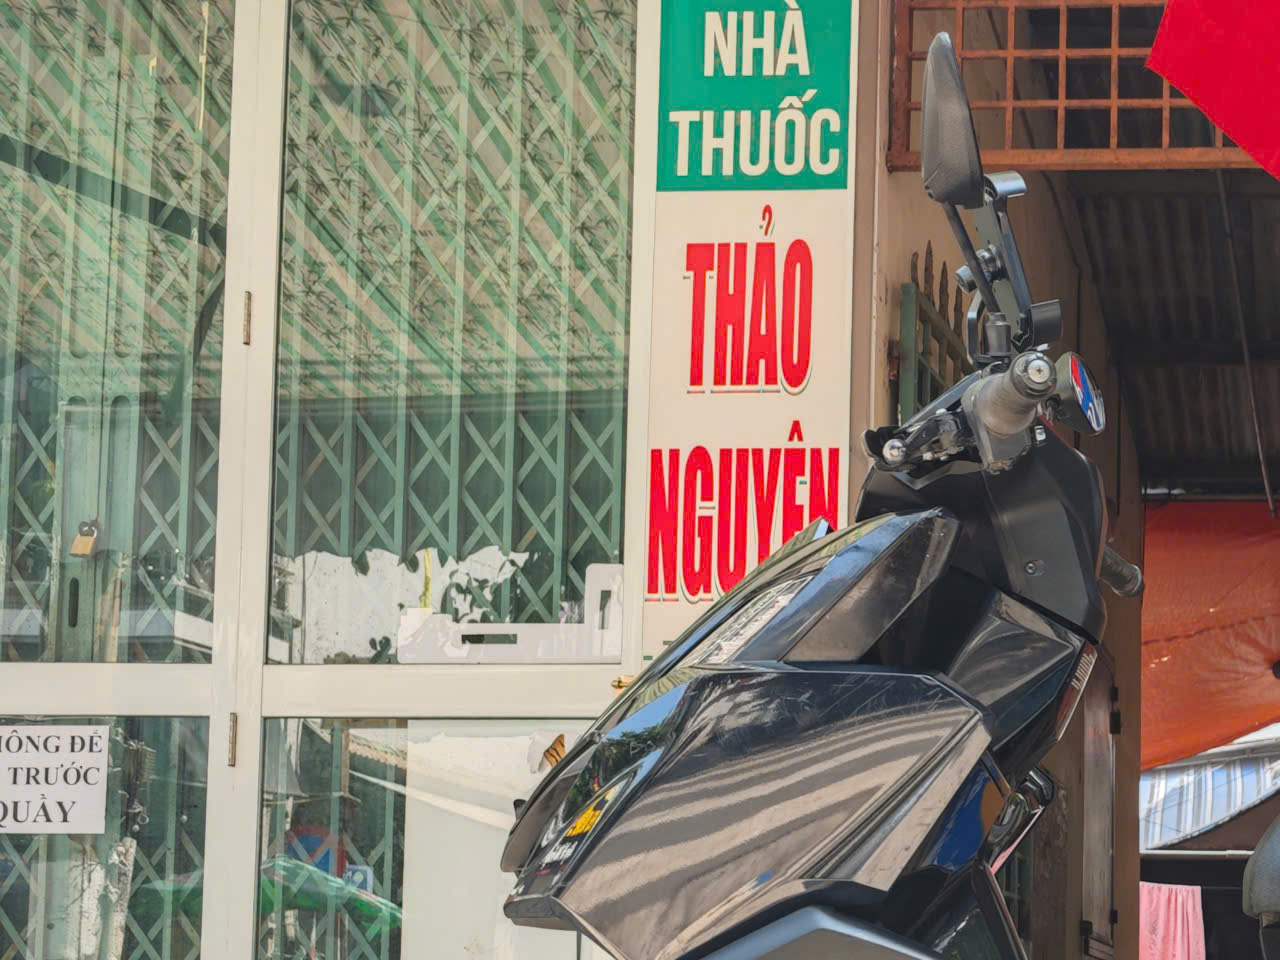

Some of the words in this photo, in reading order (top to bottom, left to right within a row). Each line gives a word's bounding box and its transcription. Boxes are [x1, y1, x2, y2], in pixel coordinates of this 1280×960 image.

[704, 0, 810, 76] NHÀ
[668, 89, 841, 176] THUỐC
[685, 204, 813, 388] THẢO
[646, 420, 840, 597] NGUYÊN
[8, 761, 101, 786] TRƯỚC
